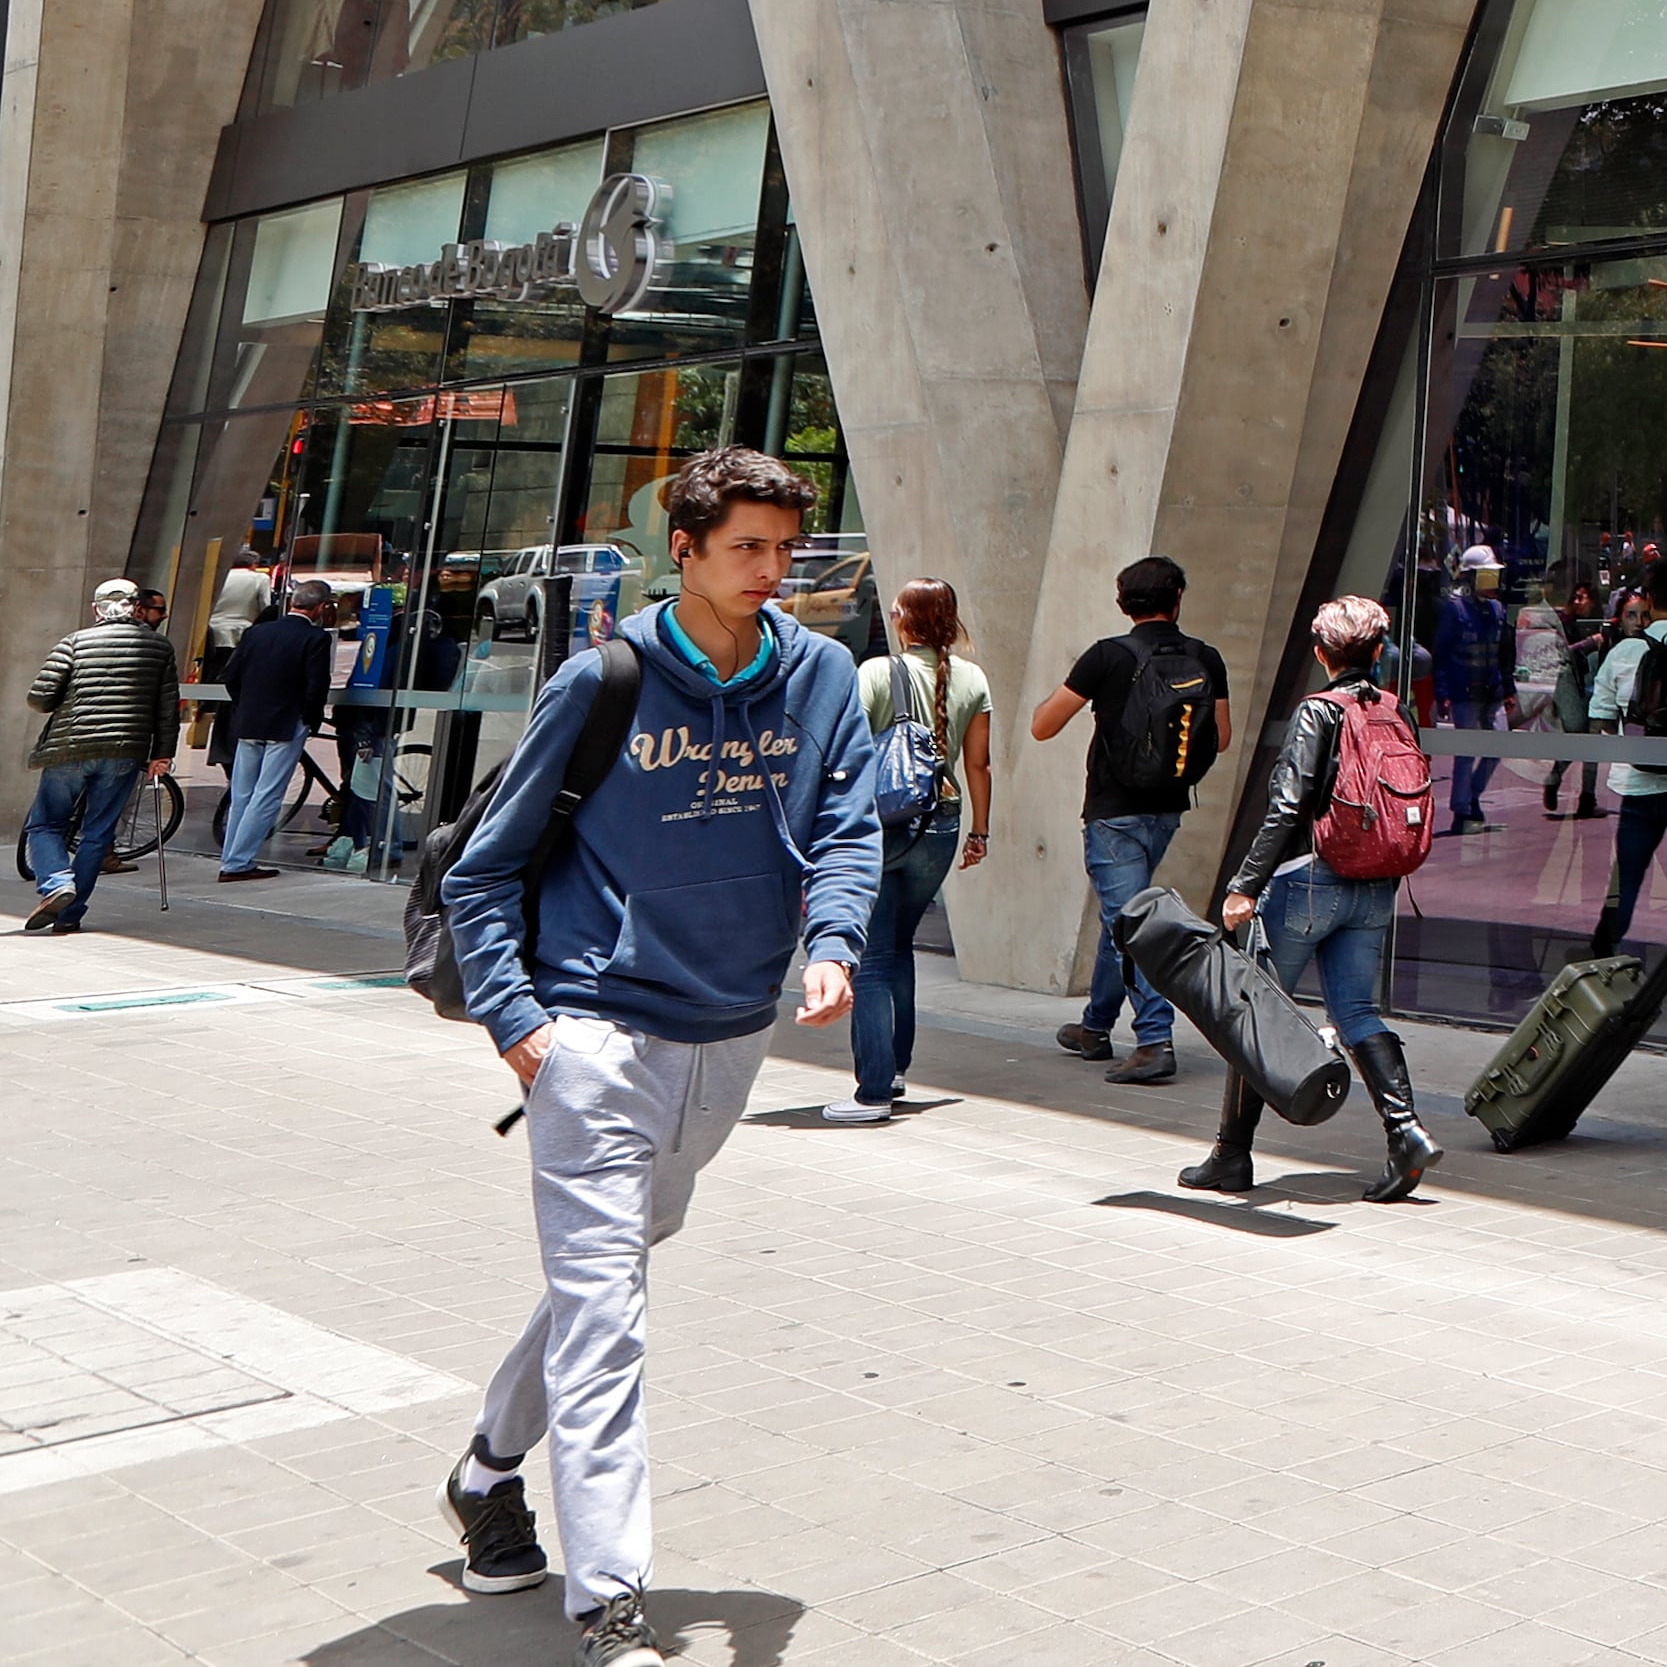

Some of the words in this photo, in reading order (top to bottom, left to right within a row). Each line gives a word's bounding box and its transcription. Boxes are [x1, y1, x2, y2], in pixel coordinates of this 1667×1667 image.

[350, 262, 426, 313] Banco
[428, 242, 461, 296] de
[463, 221, 578, 302] Bogotá
